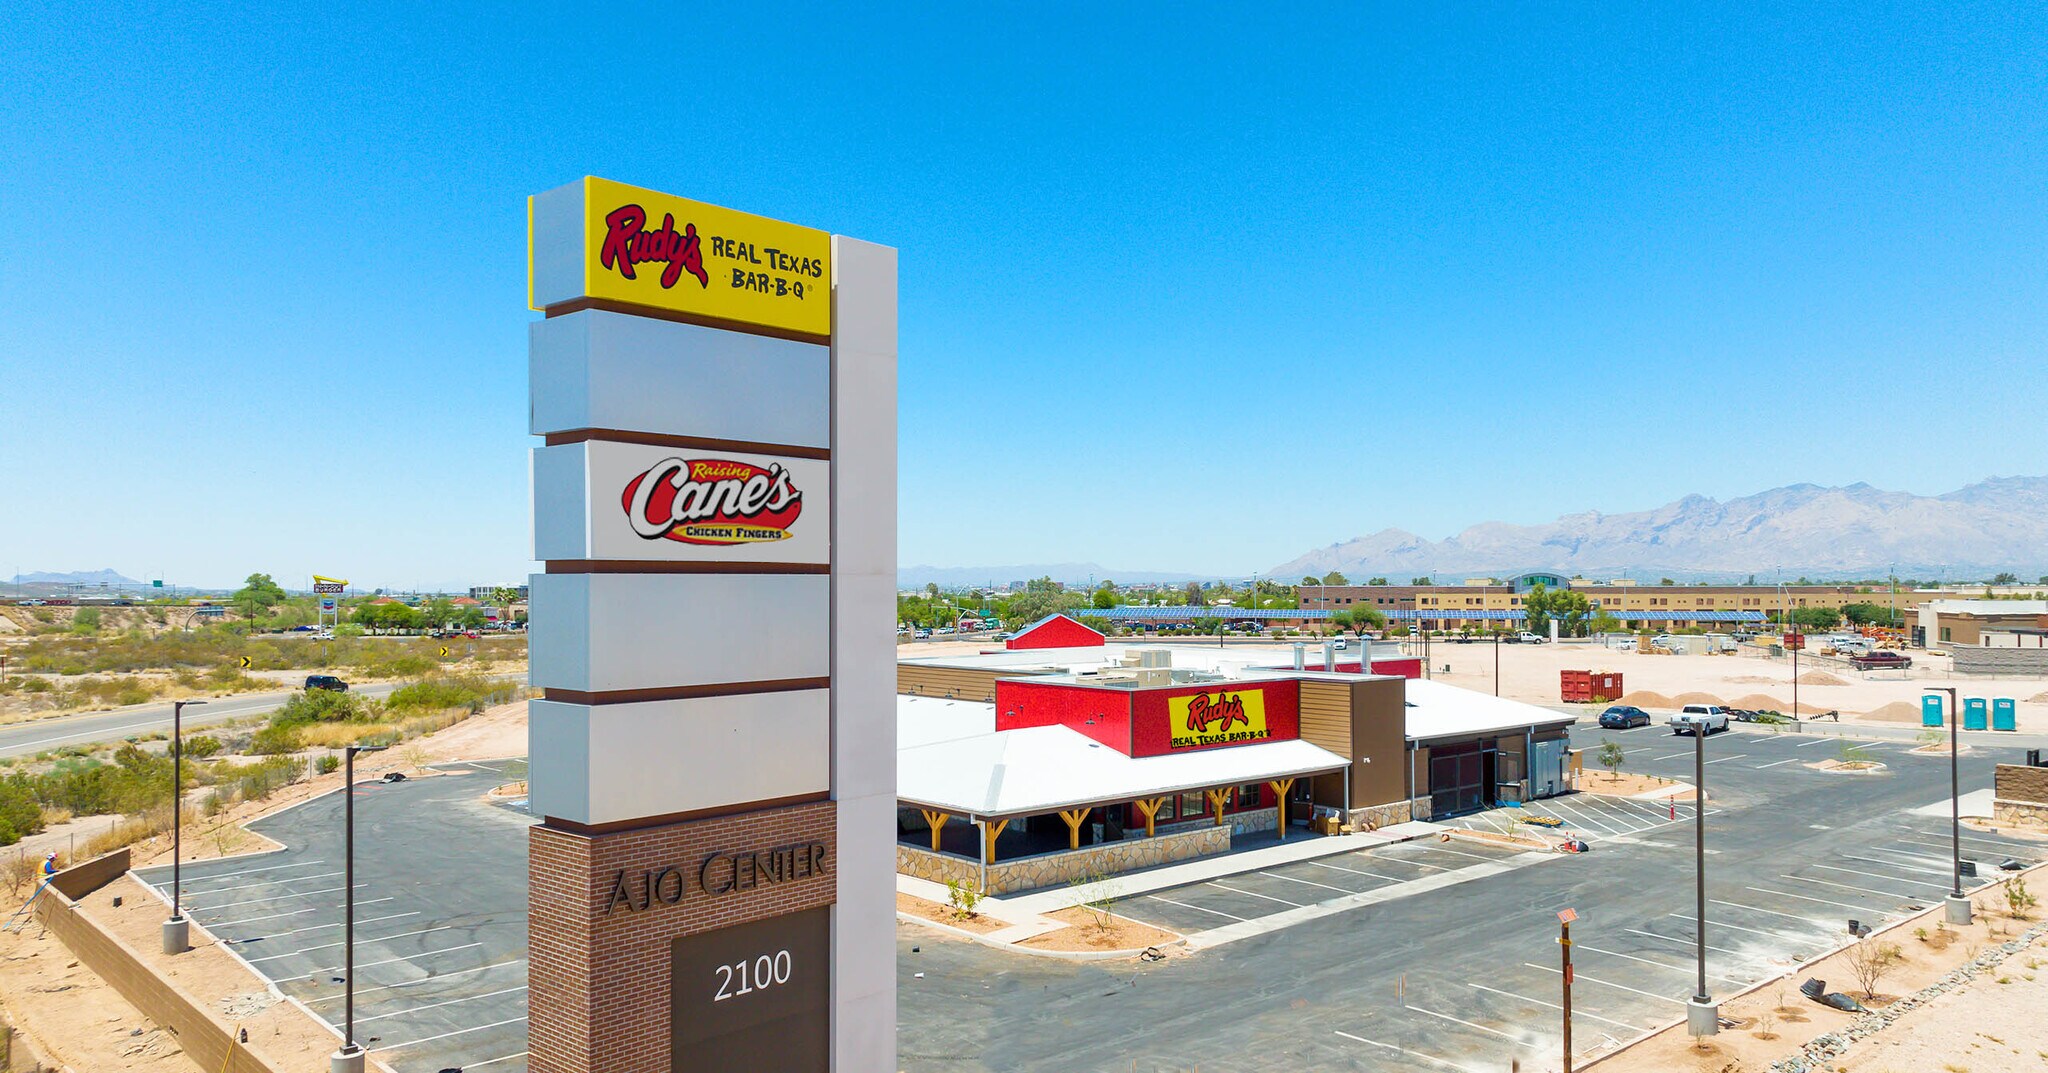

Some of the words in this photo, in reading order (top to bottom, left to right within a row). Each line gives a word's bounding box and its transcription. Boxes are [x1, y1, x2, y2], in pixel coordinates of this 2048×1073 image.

[600, 204, 709, 289] Rudy's
[711, 236, 762, 264] REAL
[764, 248, 823, 278] TEXAS
[731, 268, 804, 300] BAR-B-Q
[692, 463, 751, 481] Raising
[629, 457, 803, 540] Cane's
[686, 526, 733, 538] CHICKEN
[735, 527, 782, 539] FINGERS
[1187, 693, 1249, 732] Rudy's
[1171, 738, 1196, 749] REAL
[1197, 733, 1227, 746] TEXAS
[607, 867, 687, 917] AJO
[700, 843, 828, 897] CENTER
[714, 949, 792, 1002] 2100
